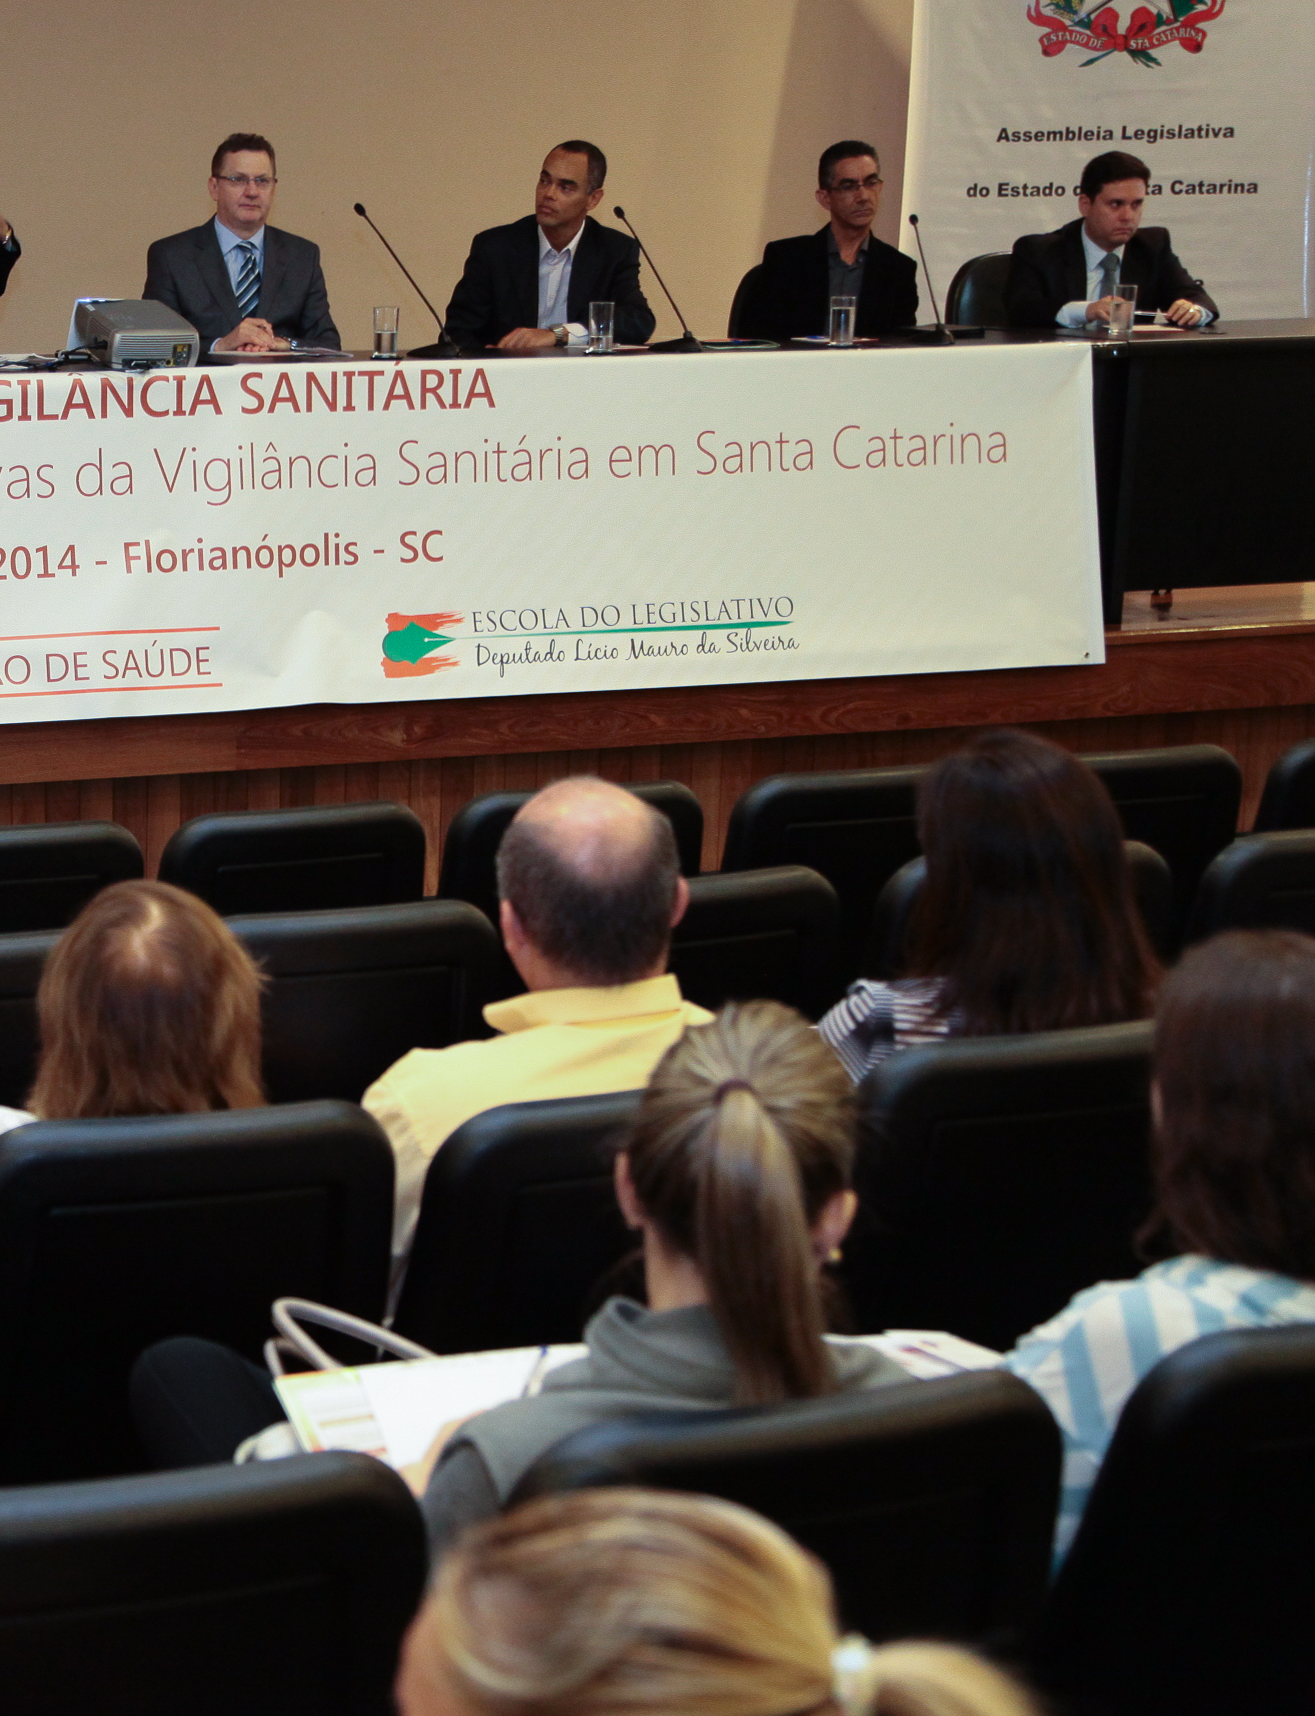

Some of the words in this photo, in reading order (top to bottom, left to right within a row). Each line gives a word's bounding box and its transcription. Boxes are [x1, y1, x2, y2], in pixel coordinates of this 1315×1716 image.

[1042, 29, 1086, 47] ESTADO
[1088, 36, 1105, 50] DE
[1152, 25, 1204, 46] CATARINA
[996, 125, 1114, 143] Assembleia
[1121, 123, 1235, 144] Legislativa
[966, 182, 991, 198] do
[997, 181, 1066, 198] Estado
[1169, 179, 1259, 197] Catarina
[240, 361, 496, 415] SANITÁRIA
[75, 447, 134, 498] da
[153, 441, 377, 507] Vigilância
[398, 434, 589, 486] Sanitária
[608, 443, 676, 479] em
[696, 430, 814, 476] Santa
[832, 422, 1007, 470] Catarina
[123, 532, 359, 580] Florianópolis
[399, 529, 444, 564] SC
[472, 607, 571, 633] ESCOLA
[580, 604, 621, 628] DO
[631, 596, 794, 625] LEGISLATIVO
[45, 651, 90, 683] DE
[102, 639, 212, 680] SAÚDE
[475, 638, 566, 678] Deputado
[573, 638, 619, 662] Lício
[625, 638, 689, 661] Mauro
[696, 631, 721, 655] da
[726, 628, 800, 654] Silveira
